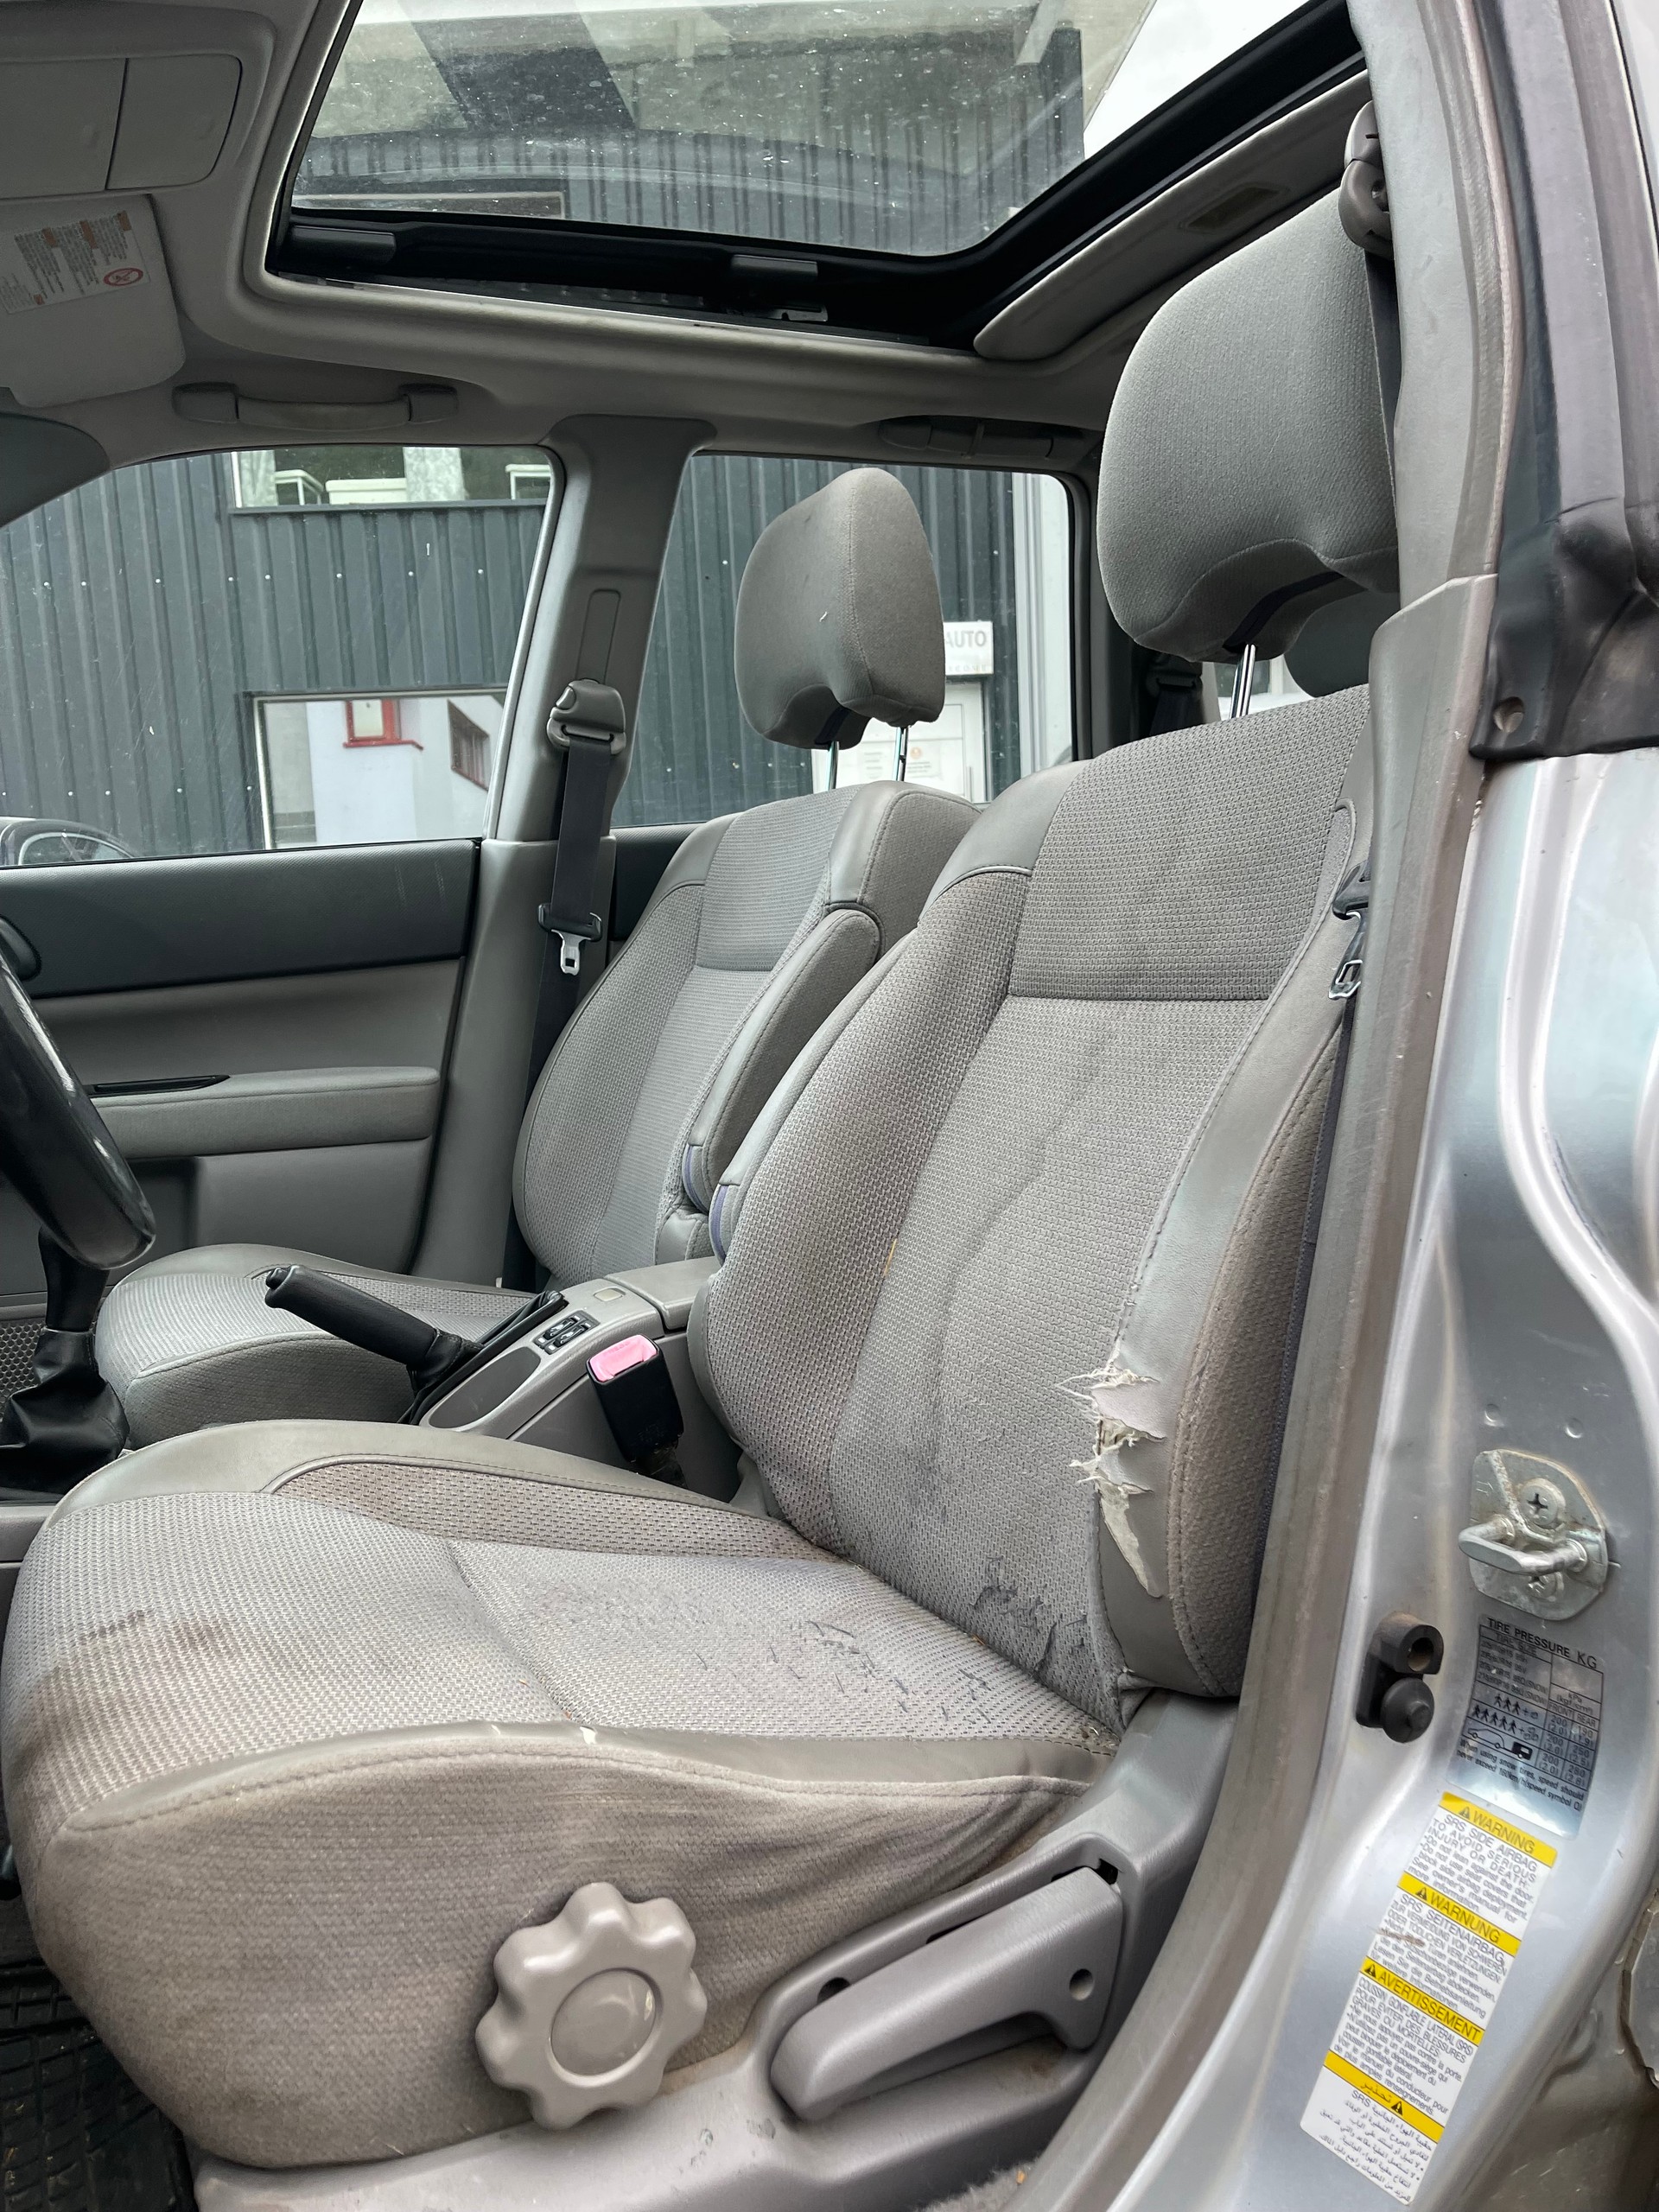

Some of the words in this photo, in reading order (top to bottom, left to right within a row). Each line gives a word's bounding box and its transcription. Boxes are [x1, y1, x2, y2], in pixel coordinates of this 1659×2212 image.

[945, 630, 987, 649] AUTO
[1487, 1618, 1510, 1634] TIRE
[1514, 1628, 1570, 1657] PRESSURE
[1576, 1651, 1597, 1669] KG
[1548, 1701, 1572, 1718] FRONT
[1538, 1774, 1558, 1789] speed
[1560, 1783, 1584, 1801] should
[1548, 1789, 1571, 1806] symbol
[1427, 1826, 1466, 1852] INJURY
[1443, 1814, 1466, 1832] SRS
[1468, 1827, 1494, 1847] SIDE
[1496, 1843, 1538, 1872] AIRBAG
[1470, 1809, 1537, 1854] WARNING
[1448, 1828, 1484, 1853] AVOID
[1486, 1849, 1537, 1883] SERIOUS
[1407, 1865, 1429, 1882] more
[1469, 1860, 1498, 1883] against
[1417, 1850, 1438, 1866] block
[1455, 1873, 1481, 1893] airbag
[1480, 1888, 1529, 1921] deployment.
[1431, 1868, 1465, 1893] owner's
[1467, 1890, 1502, 1915] manual
[1482, 1878, 1509, 1898] covers
[1399, 1893, 1423, 1913] SRS
[1387, 1909, 1407, 1926] ODER
[1427, 1891, 1502, 1943] WARNUNG
[1373, 1942, 1395, 1961] Lesen
[1405, 1909, 1451, 1942] VERMEIDUNG
[1466, 1946, 1508, 1976] SCHWEREN
[1381, 1958, 1408, 1979] weitere
[1351, 1994, 1382, 2018] GRAVES
[1357, 1977, 1388, 2001] COUSSIN
[1387, 1995, 1426, 2026] GONFLABLE
[1454, 2037, 1474, 2057] (SRS)
[1377, 1969, 1480, 2042] AVERTISSEMENT
[1354, 1986, 1376, 2005] POUR
[1422, 2031, 1466, 2063] BLESSURES
[1342, 2029, 1365, 2049] coussin
[1365, 2044, 1393, 2068] gonflable
[1359, 2031, 1382, 2051] bloquer
[1376, 2023, 1403, 2045] appuyez
[1416, 2048, 1437, 2065] contre
[1444, 2065, 1463, 2083] porte.
[1359, 2061, 1382, 2082] amples
[1360, 2050, 1383, 2071] manuel
[1395, 2075, 1431, 2103] conducteur
[1351, 2089, 1371, 2107] SRS
[1360, 2077, 1392, 2106] تحذير
